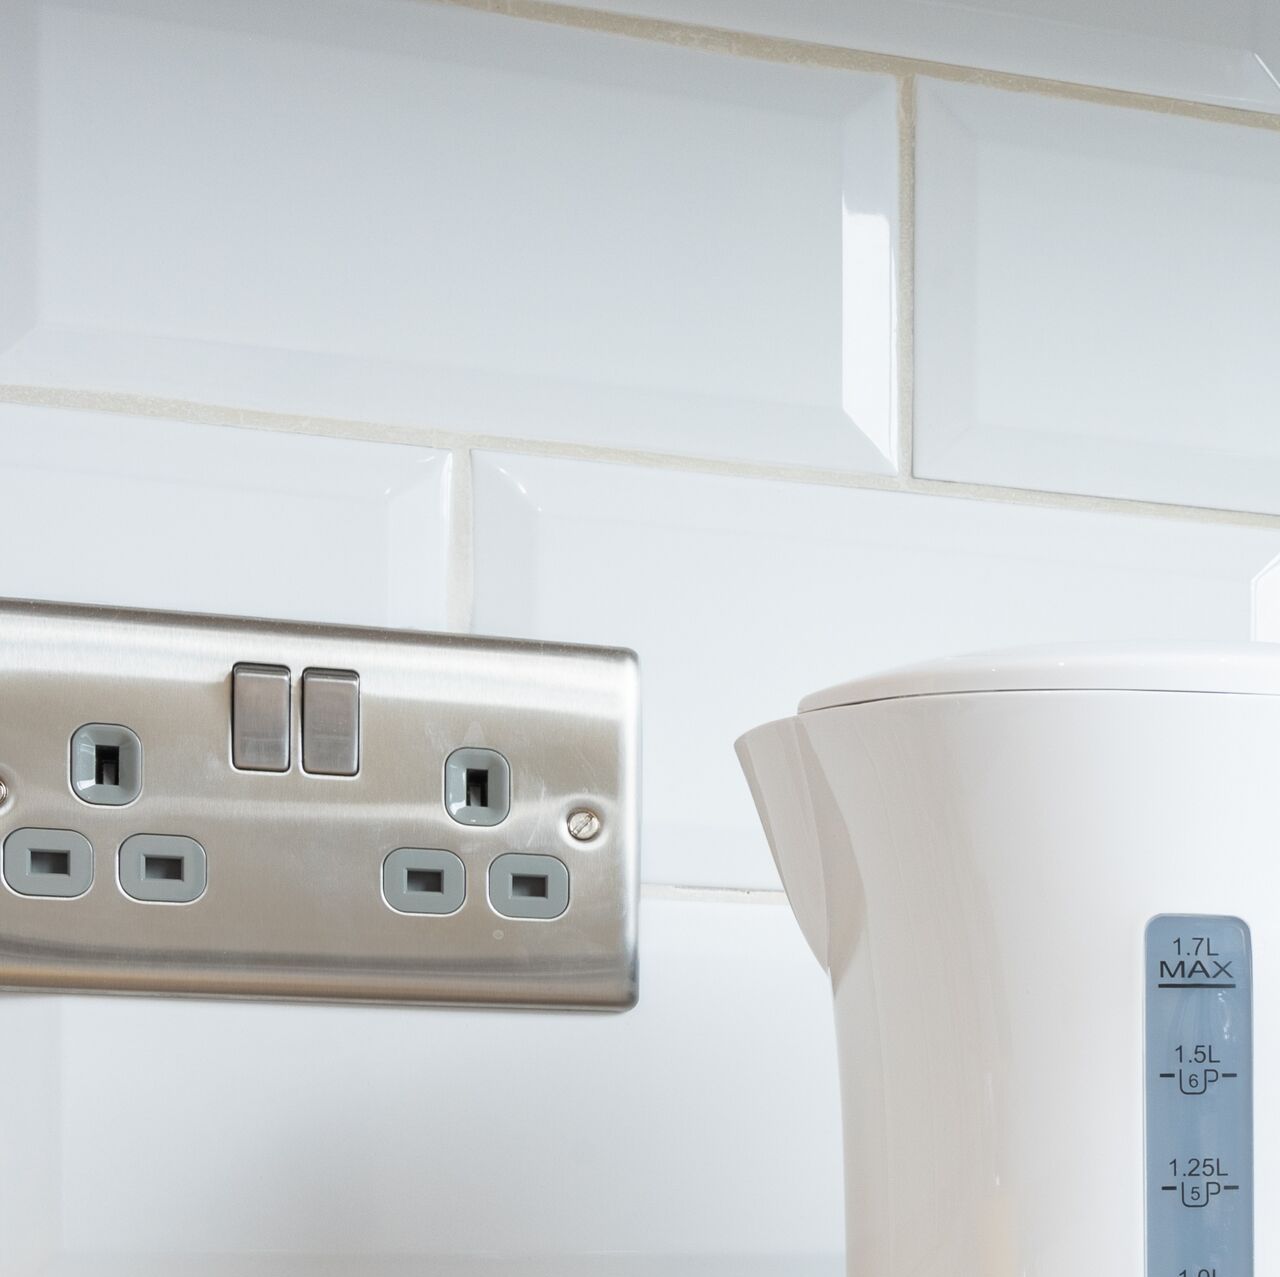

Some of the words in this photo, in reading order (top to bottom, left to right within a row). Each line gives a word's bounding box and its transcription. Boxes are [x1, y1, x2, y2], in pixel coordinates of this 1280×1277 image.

[1172, 937, 1219, 956] 1.7L
[1159, 960, 1233, 979] MAX
[1175, 1044, 1221, 1064] 1.5L
[1169, 1158, 1229, 1177] 1.25L
